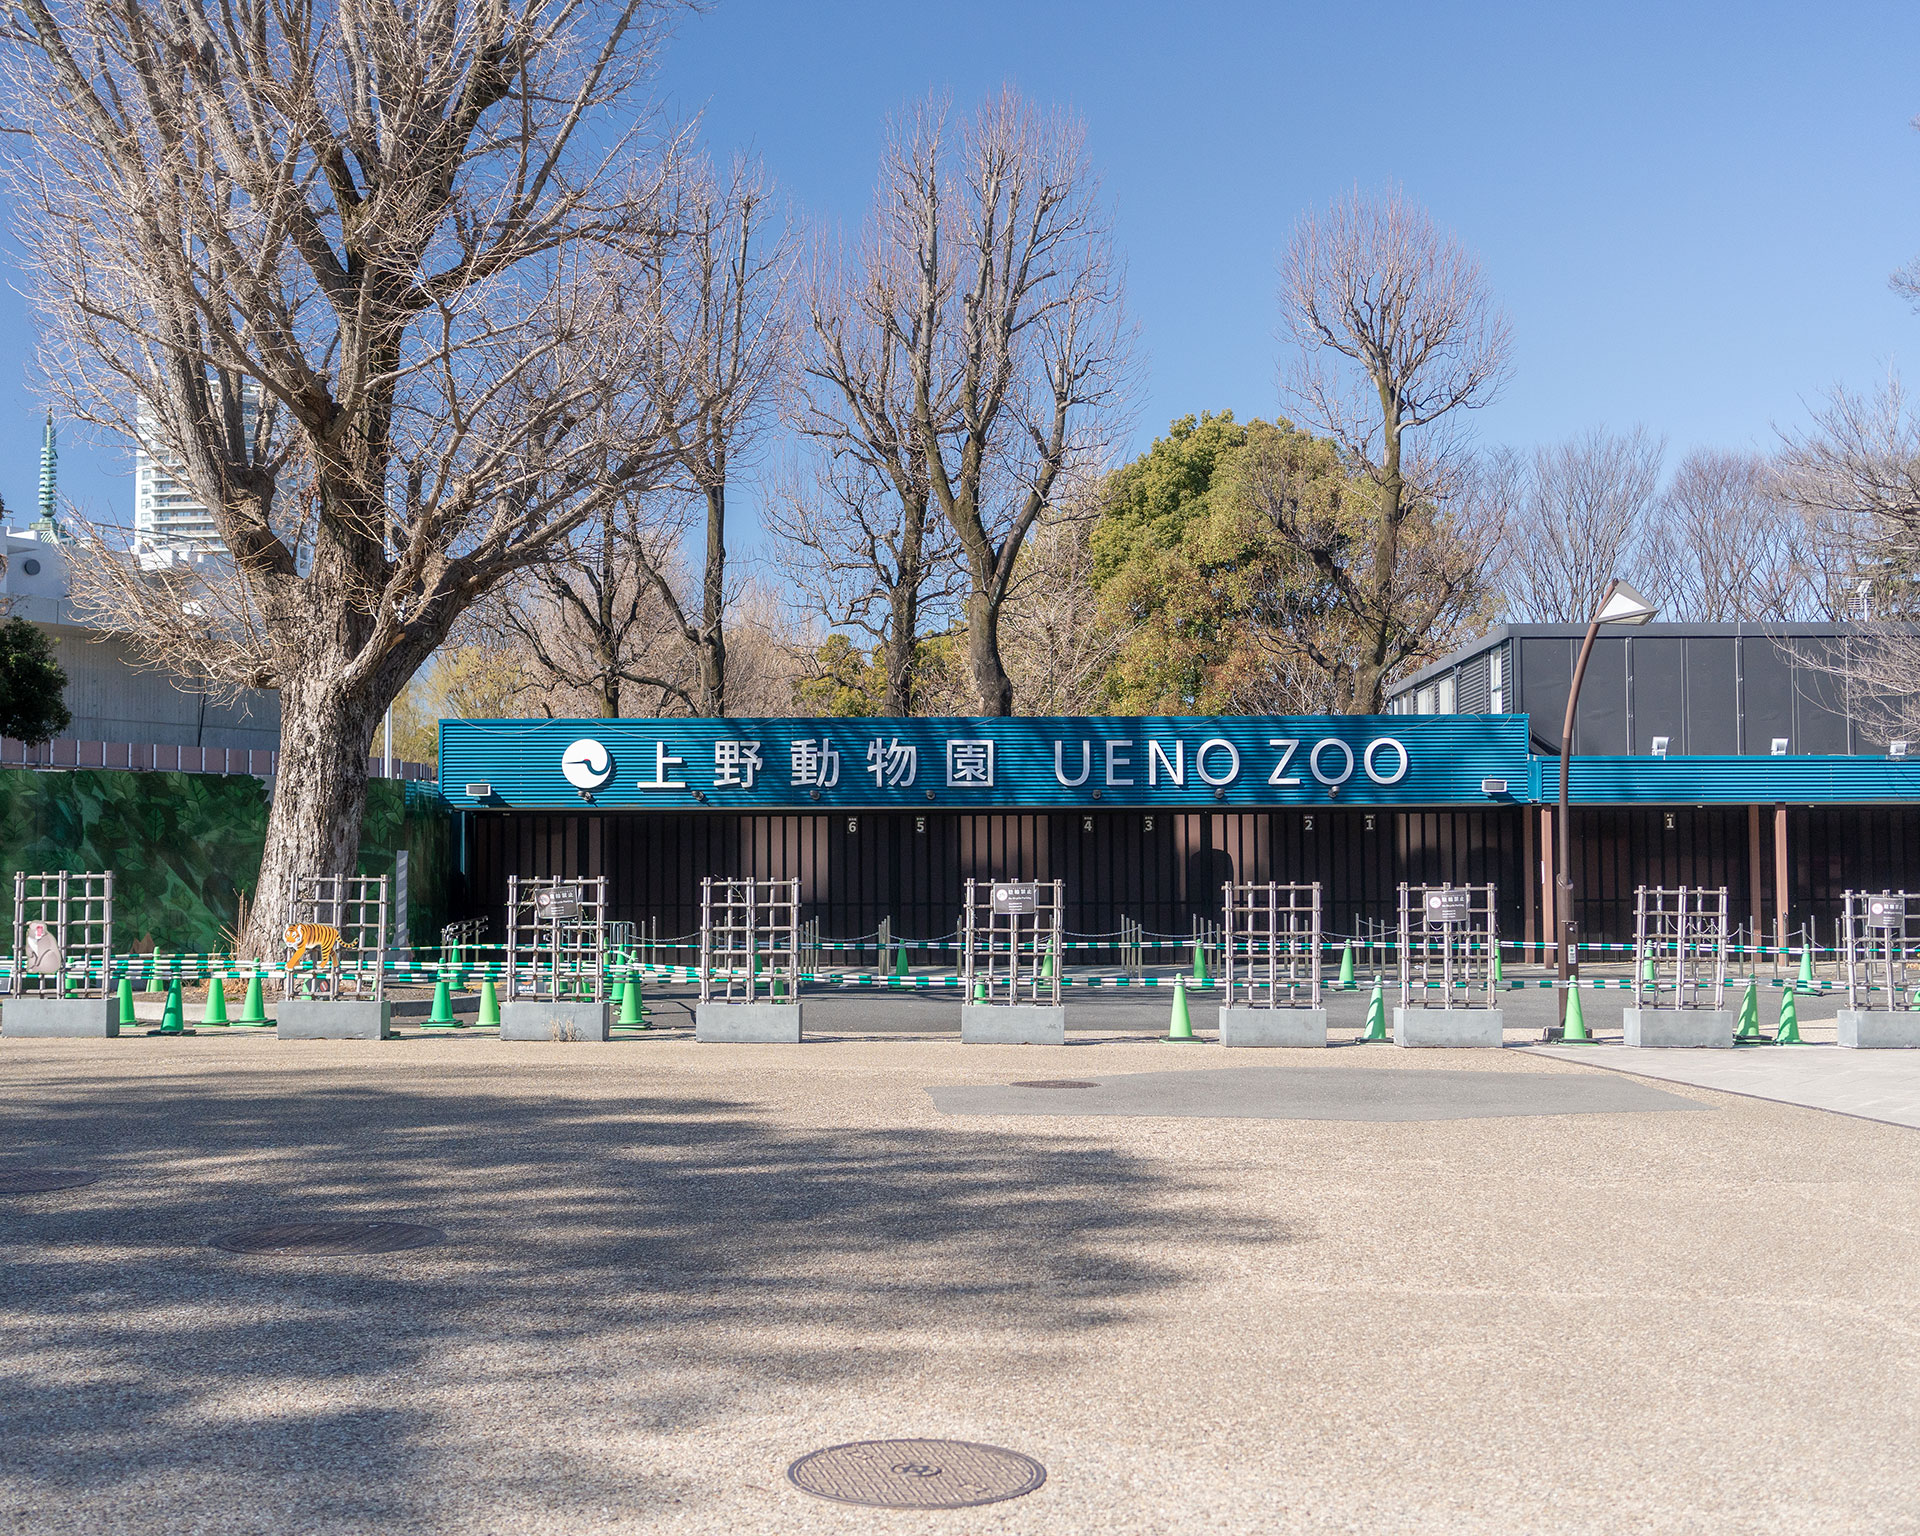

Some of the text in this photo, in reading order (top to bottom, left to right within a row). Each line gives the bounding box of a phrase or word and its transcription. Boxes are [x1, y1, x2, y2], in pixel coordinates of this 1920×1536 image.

[636, 738, 995, 788] 上野動物園
[1054, 738, 1409, 788] UENO ZOO
[848, 821, 857, 832] 6
[916, 821, 925, 832] 5
[1084, 820, 1093, 831] 4
[1145, 820, 1153, 831] 3
[1304, 820, 1313, 830] 2
[1366, 820, 1374, 830] 1
[1666, 818, 1674, 828] 1
